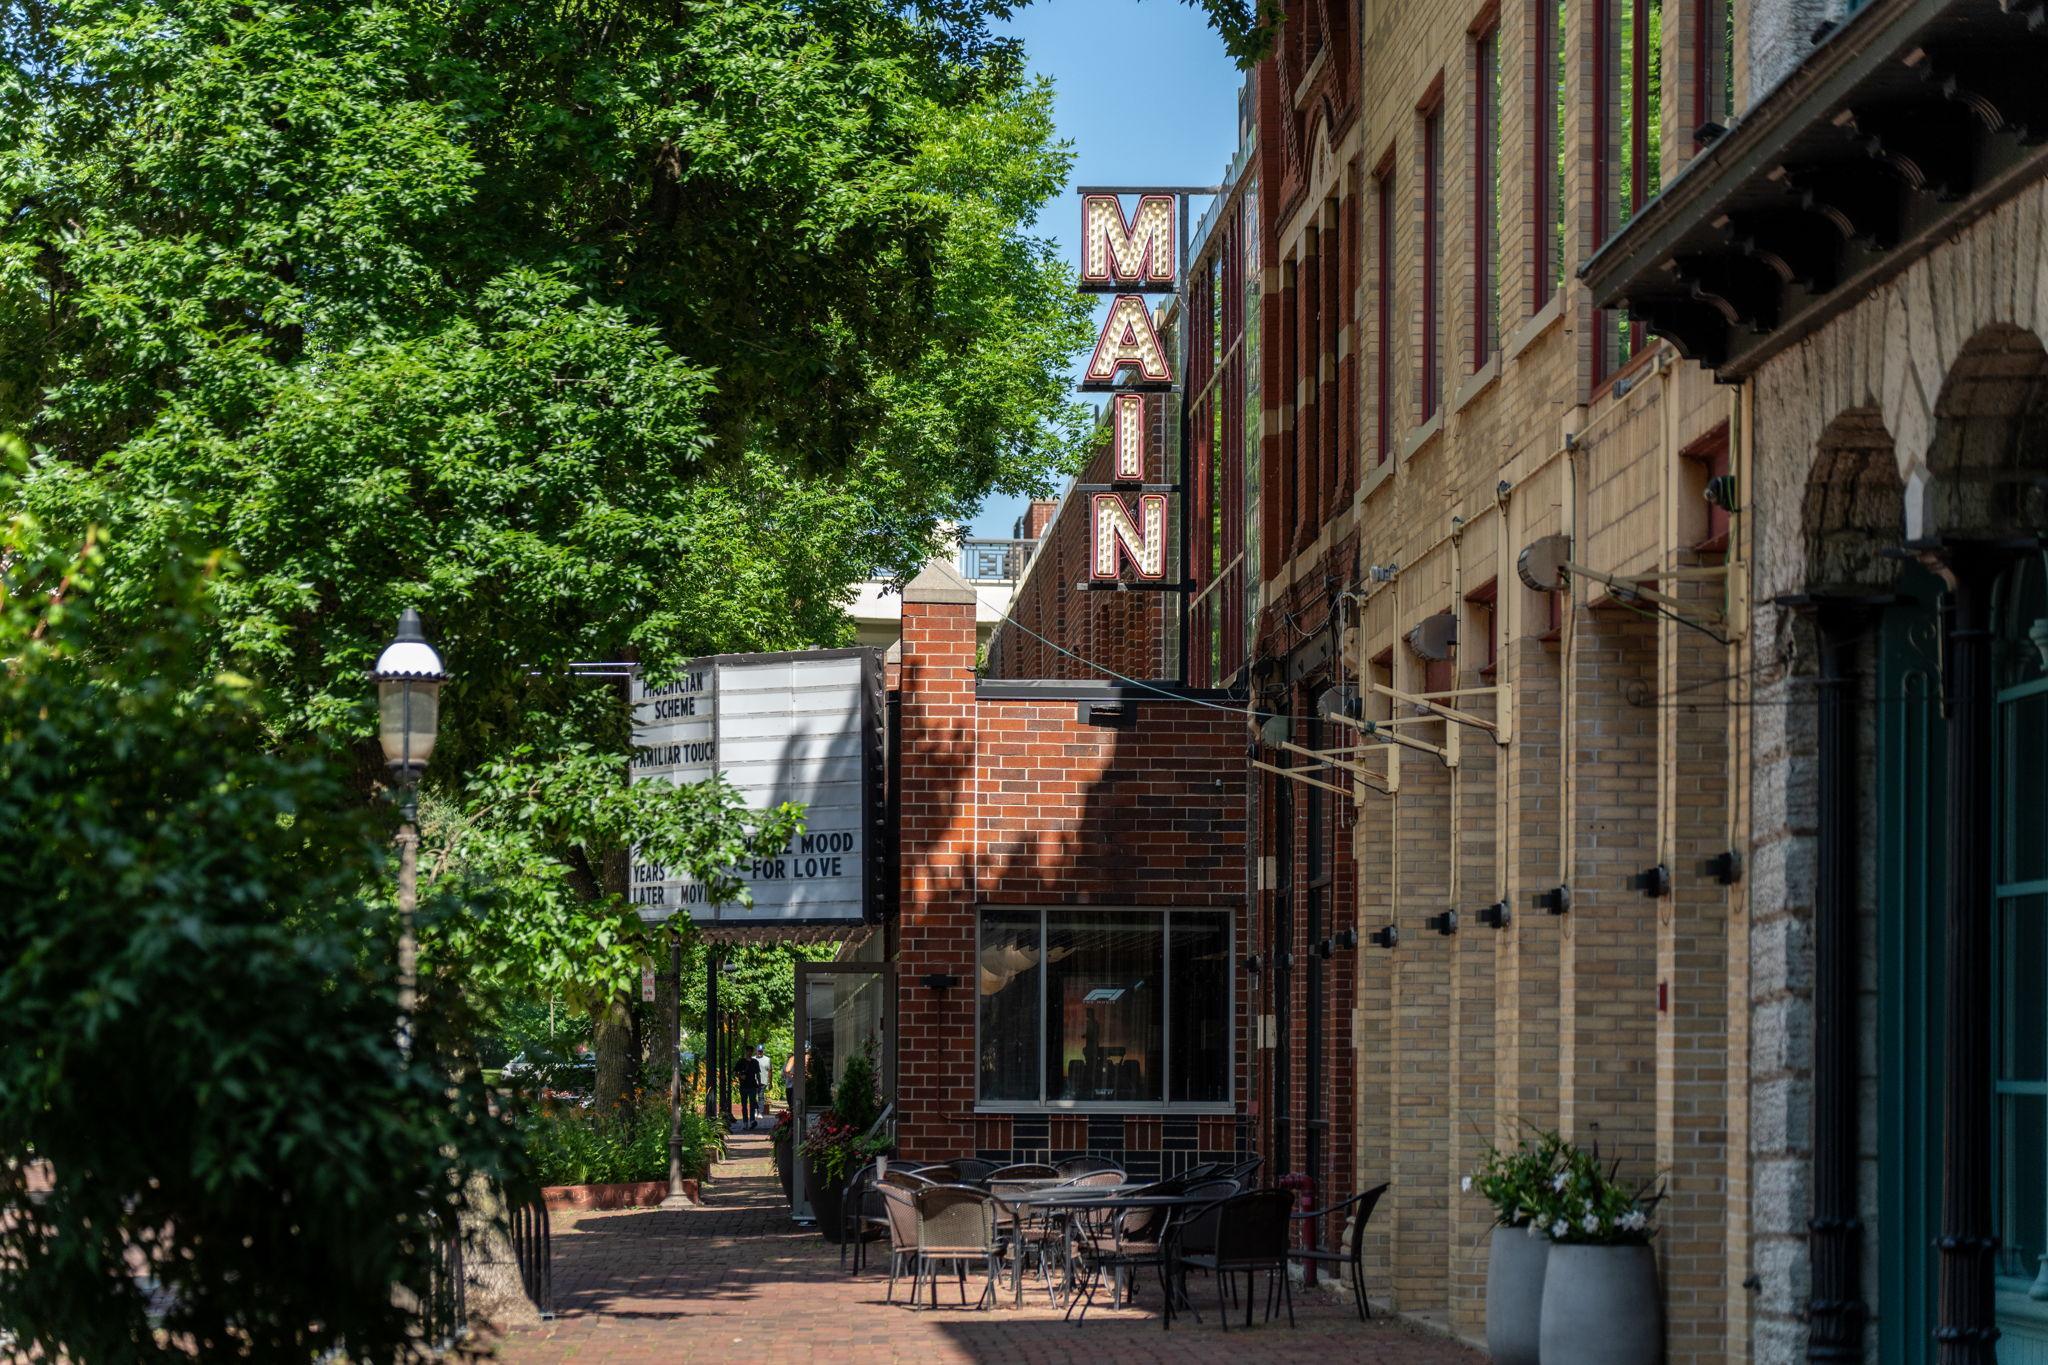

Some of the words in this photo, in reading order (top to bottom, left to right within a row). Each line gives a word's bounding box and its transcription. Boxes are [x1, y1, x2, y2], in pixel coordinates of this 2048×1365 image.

[1082, 193, 1176, 581] MAIN
[655, 697, 695, 719] SCHEME
[684, 741, 714, 762] TOUCH
[801, 832, 854, 854] MOOD
[634, 863, 665, 882] YEARS
[752, 859, 785, 879] FOR
[794, 857, 842, 878] LOVE
[634, 886, 664, 904] LATER
